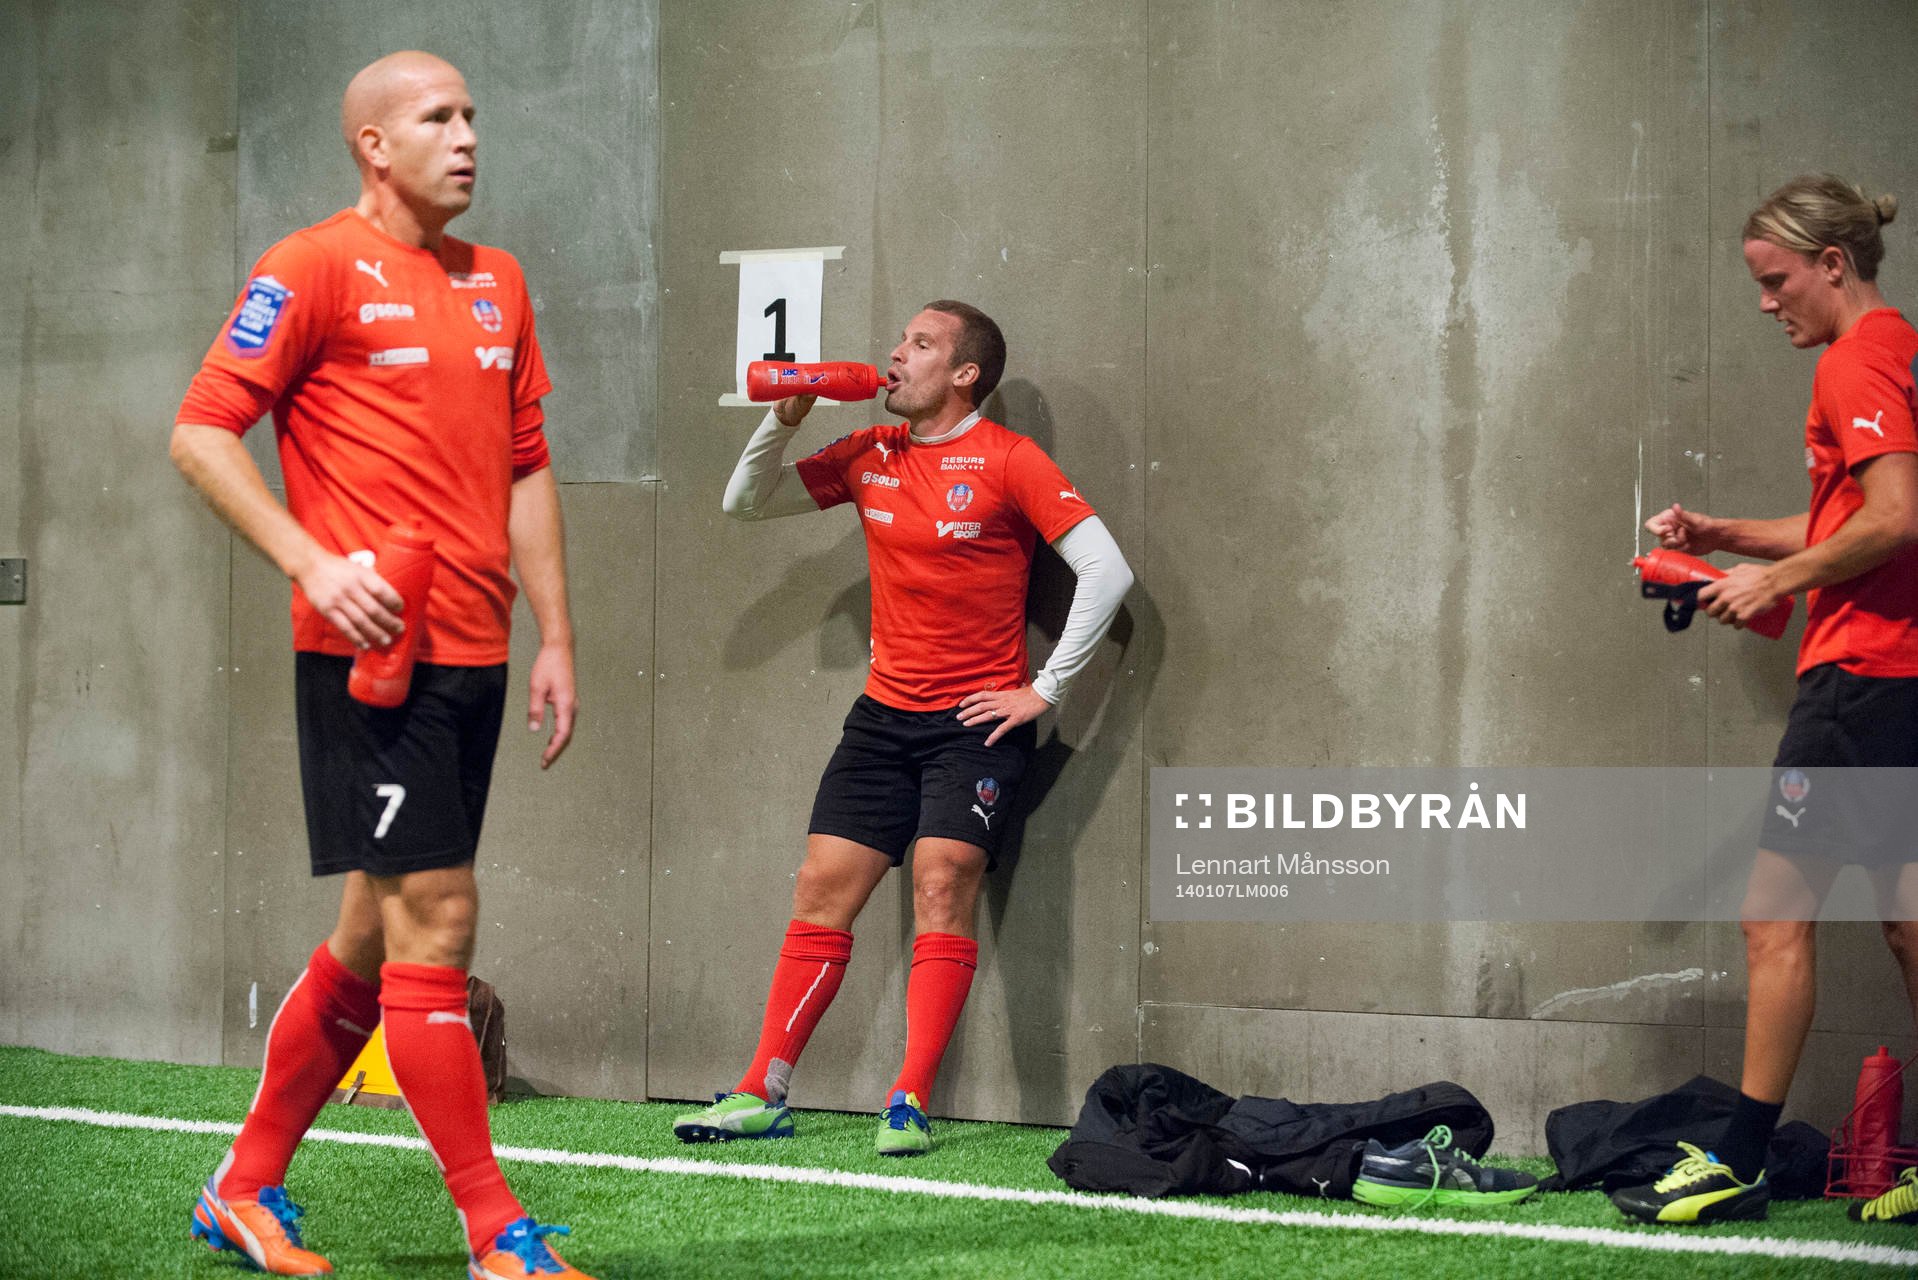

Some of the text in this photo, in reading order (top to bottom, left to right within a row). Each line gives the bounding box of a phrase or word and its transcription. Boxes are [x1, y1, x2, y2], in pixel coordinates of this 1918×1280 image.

[763, 298, 795, 361] 1
[941, 456, 985, 464] RESURS
[940, 463, 967, 471] BANK
[871, 473, 900, 487] SOLID
[953, 521, 981, 531] INTER
[952, 530, 980, 539] SPORT
[371, 783, 407, 839] 7
